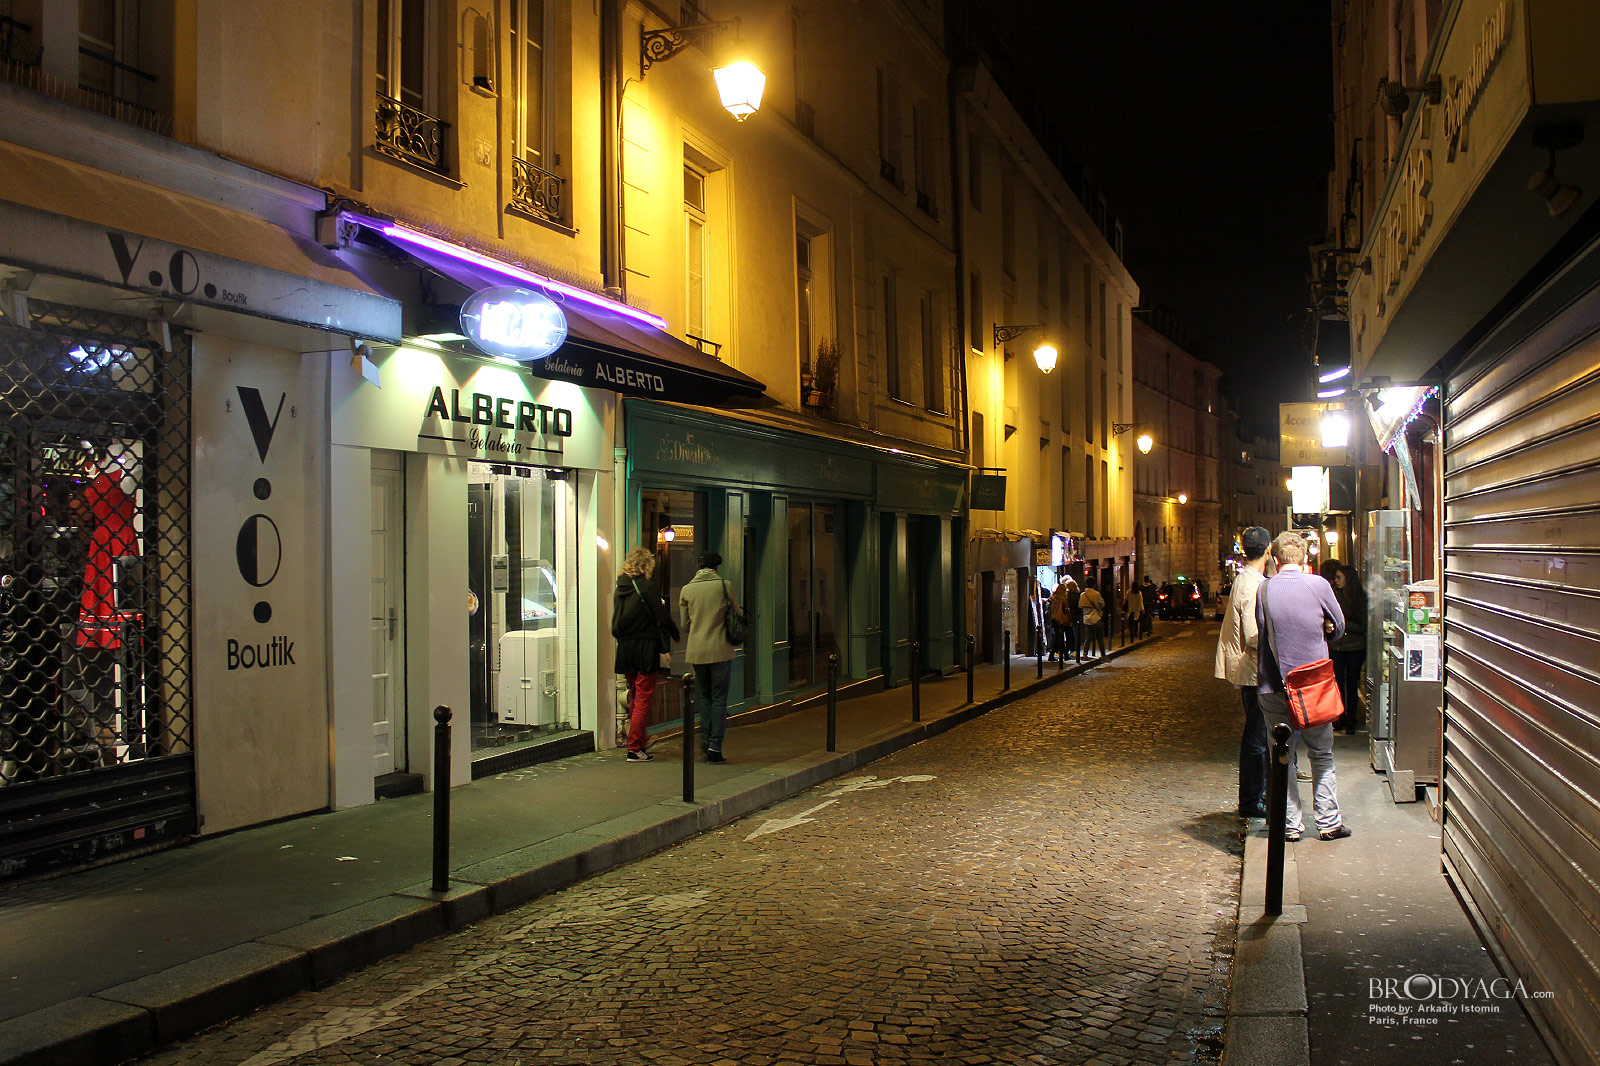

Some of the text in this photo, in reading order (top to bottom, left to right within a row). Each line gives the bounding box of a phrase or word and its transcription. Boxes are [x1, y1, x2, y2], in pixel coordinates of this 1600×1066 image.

[222, 288, 248, 305] Boutik
[595, 362, 665, 392] ALBERTO
[424, 386, 572, 437] ALBERTO
[468, 427, 525, 454] Gelateria
[227, 636, 295, 670] Boutik
